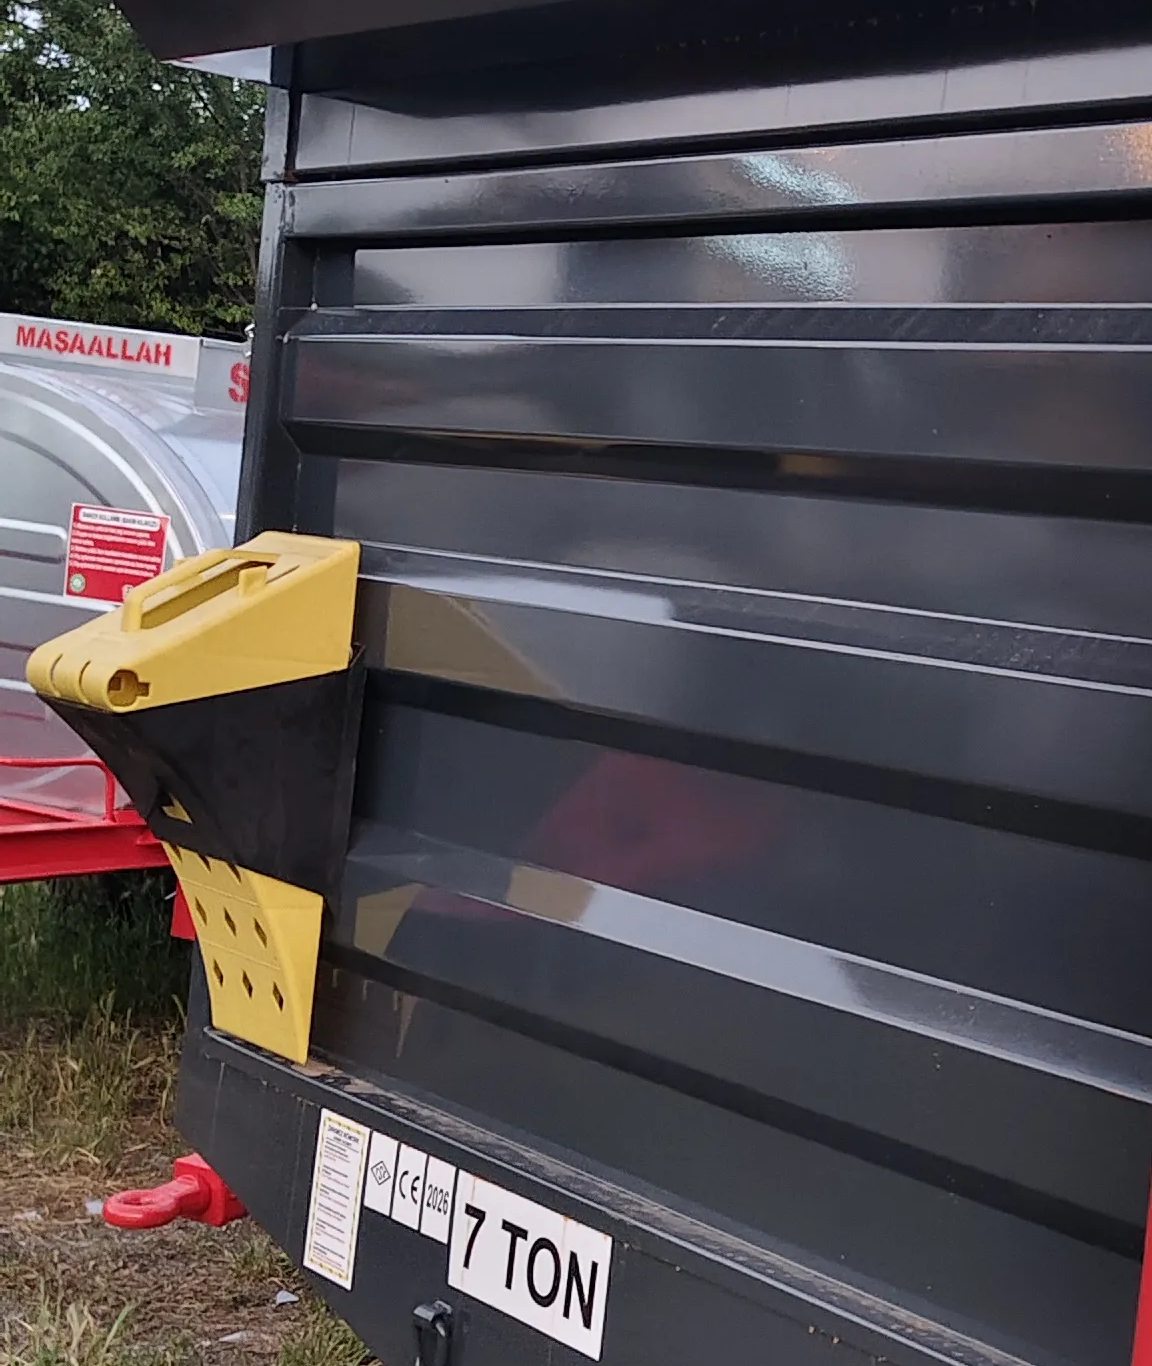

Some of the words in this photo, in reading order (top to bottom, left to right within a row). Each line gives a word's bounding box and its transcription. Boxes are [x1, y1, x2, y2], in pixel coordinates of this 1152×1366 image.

[426, 1184, 449, 1215] 2026
[463, 1203, 486, 1269] 7
[501, 1219, 599, 1330] TON
